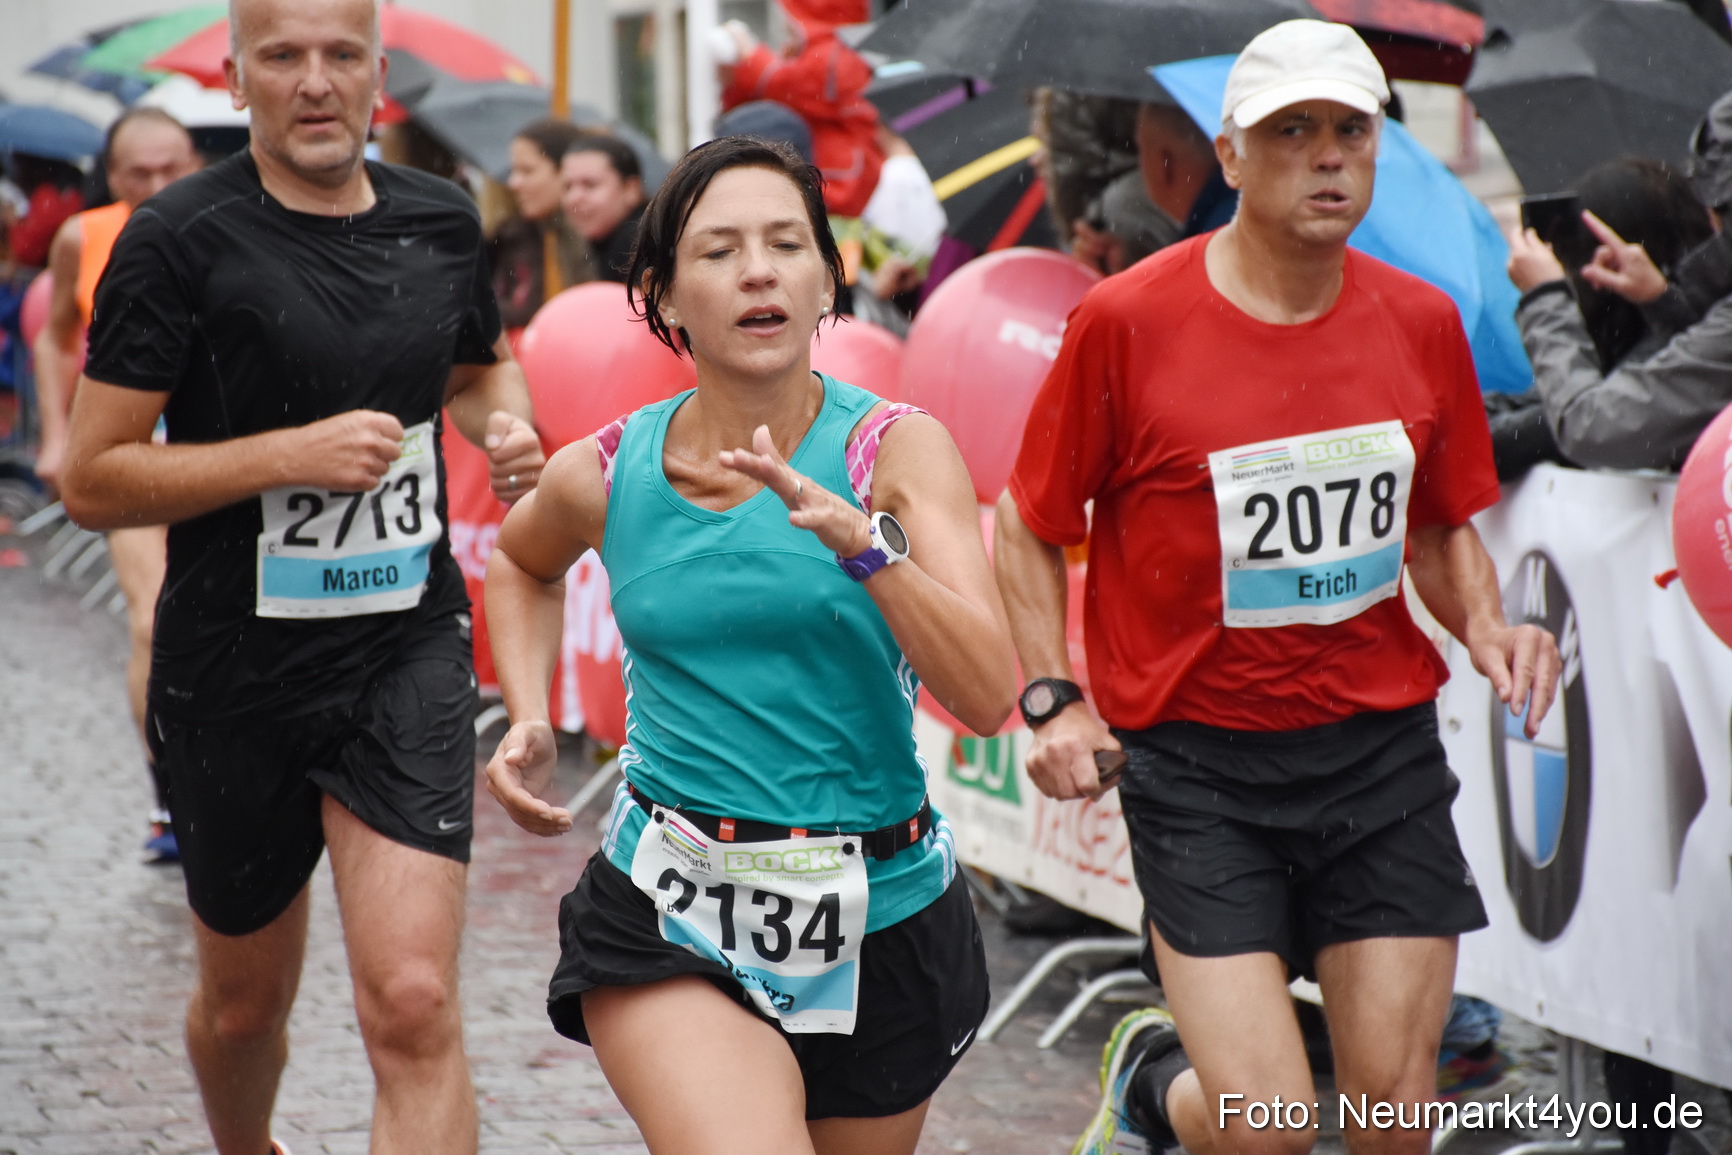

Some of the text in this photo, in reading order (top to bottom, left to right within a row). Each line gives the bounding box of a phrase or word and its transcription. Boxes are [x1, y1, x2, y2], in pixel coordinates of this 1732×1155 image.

[1304, 431, 1395, 465] BOCK
[1232, 461, 1295, 482] NeuerMarkt
[282, 473, 422, 550] 2713
[1244, 471, 1397, 561] 2078
[323, 564, 399, 592] Marco
[1232, 558, 1242, 570] C
[1298, 568, 1357, 600] Erich
[724, 846, 843, 874] BOCK
[725, 874, 762, 884] inspired
[763, 874, 775, 882] by
[805, 873, 845, 882] concepts
[656, 867, 846, 964] 2134
